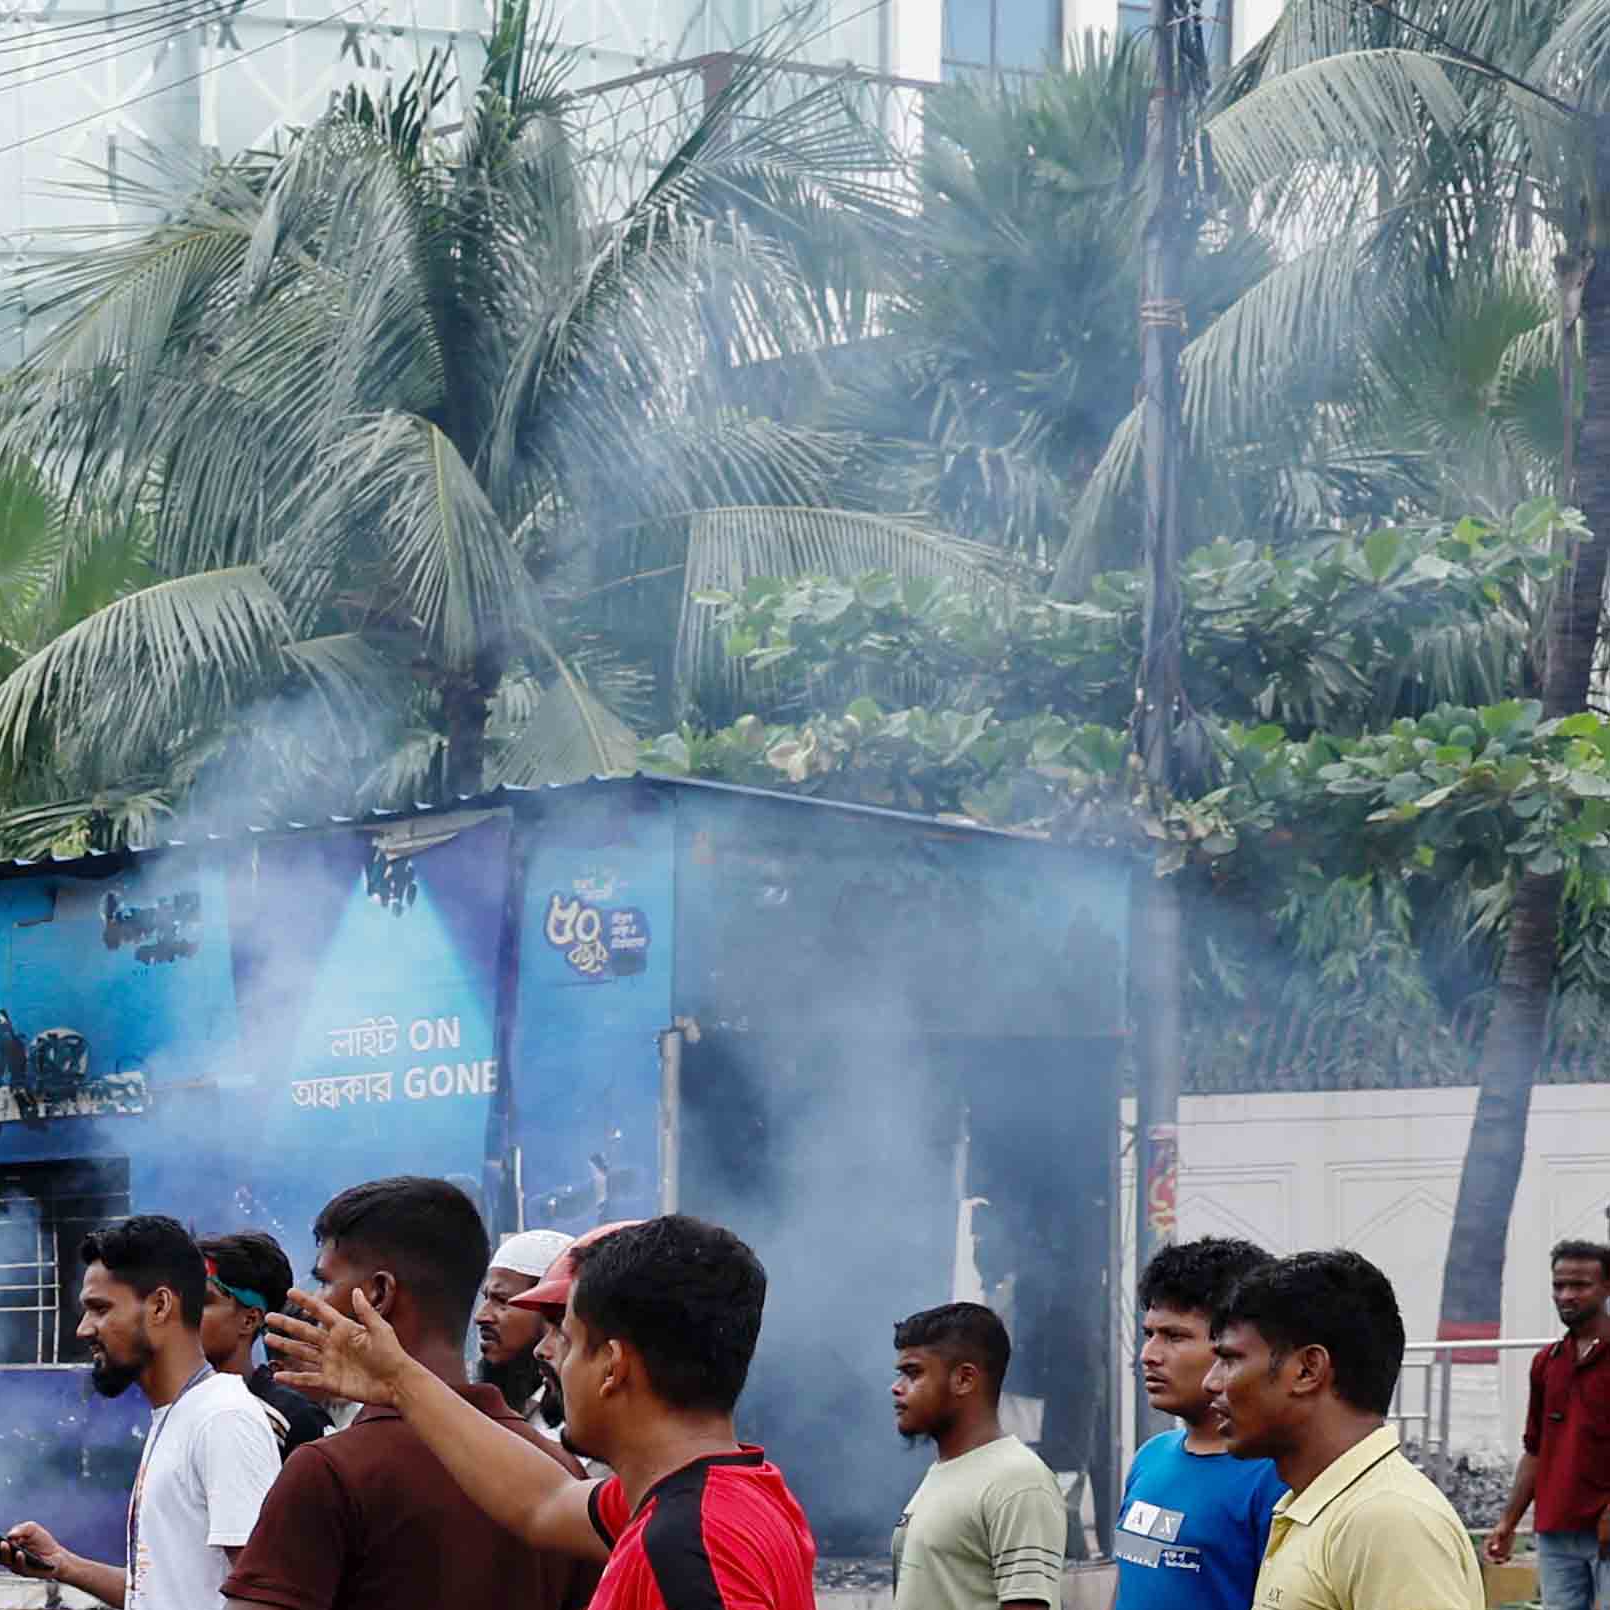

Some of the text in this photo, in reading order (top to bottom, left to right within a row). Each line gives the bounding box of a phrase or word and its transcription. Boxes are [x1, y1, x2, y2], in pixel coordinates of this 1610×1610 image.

[328, 1016, 461, 1057] লাইট ON
[292, 1060, 499, 1110] অন্ধকার GONE
